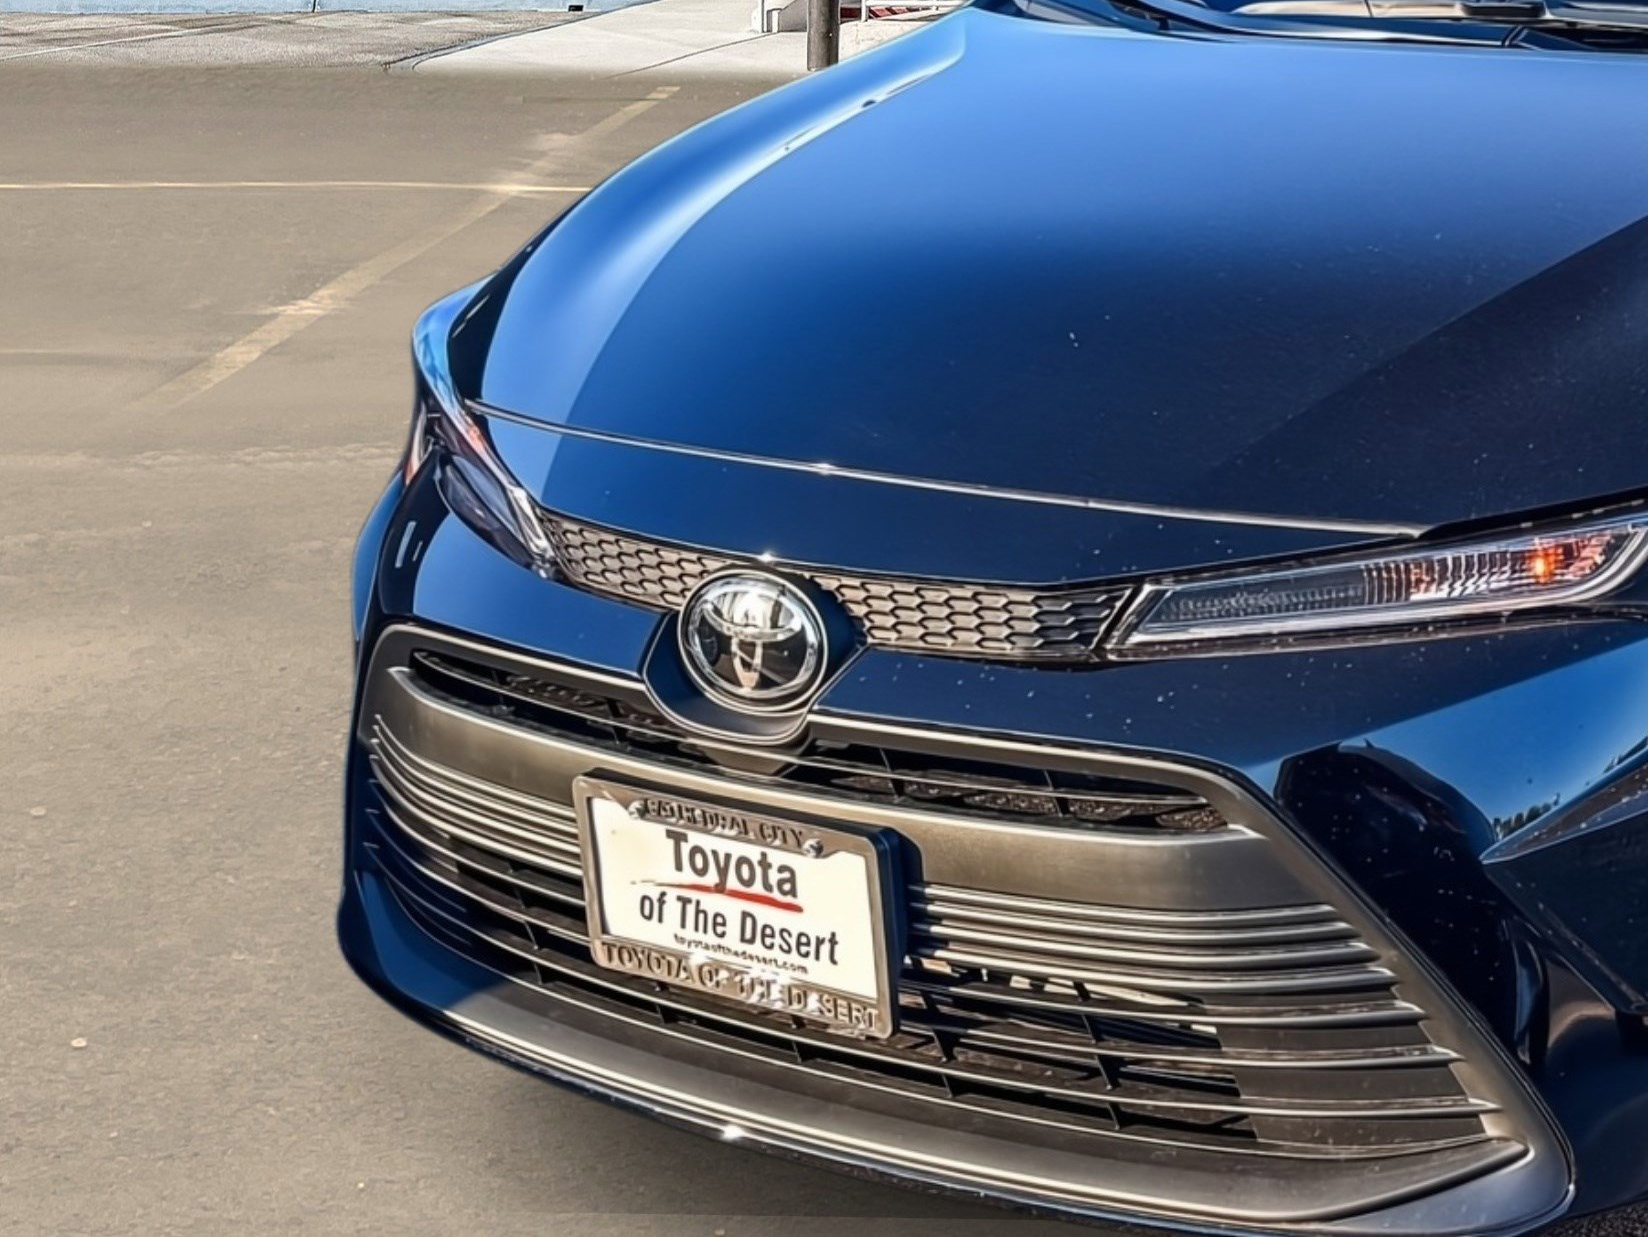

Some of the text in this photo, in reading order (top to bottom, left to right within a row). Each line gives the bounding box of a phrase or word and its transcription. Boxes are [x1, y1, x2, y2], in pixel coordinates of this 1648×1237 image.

[758, 822, 803, 849] CITY
[665, 829, 799, 899] Toyota
[639, 890, 840, 965] of The Desert
[601, 942, 693, 983] TOYOTA
